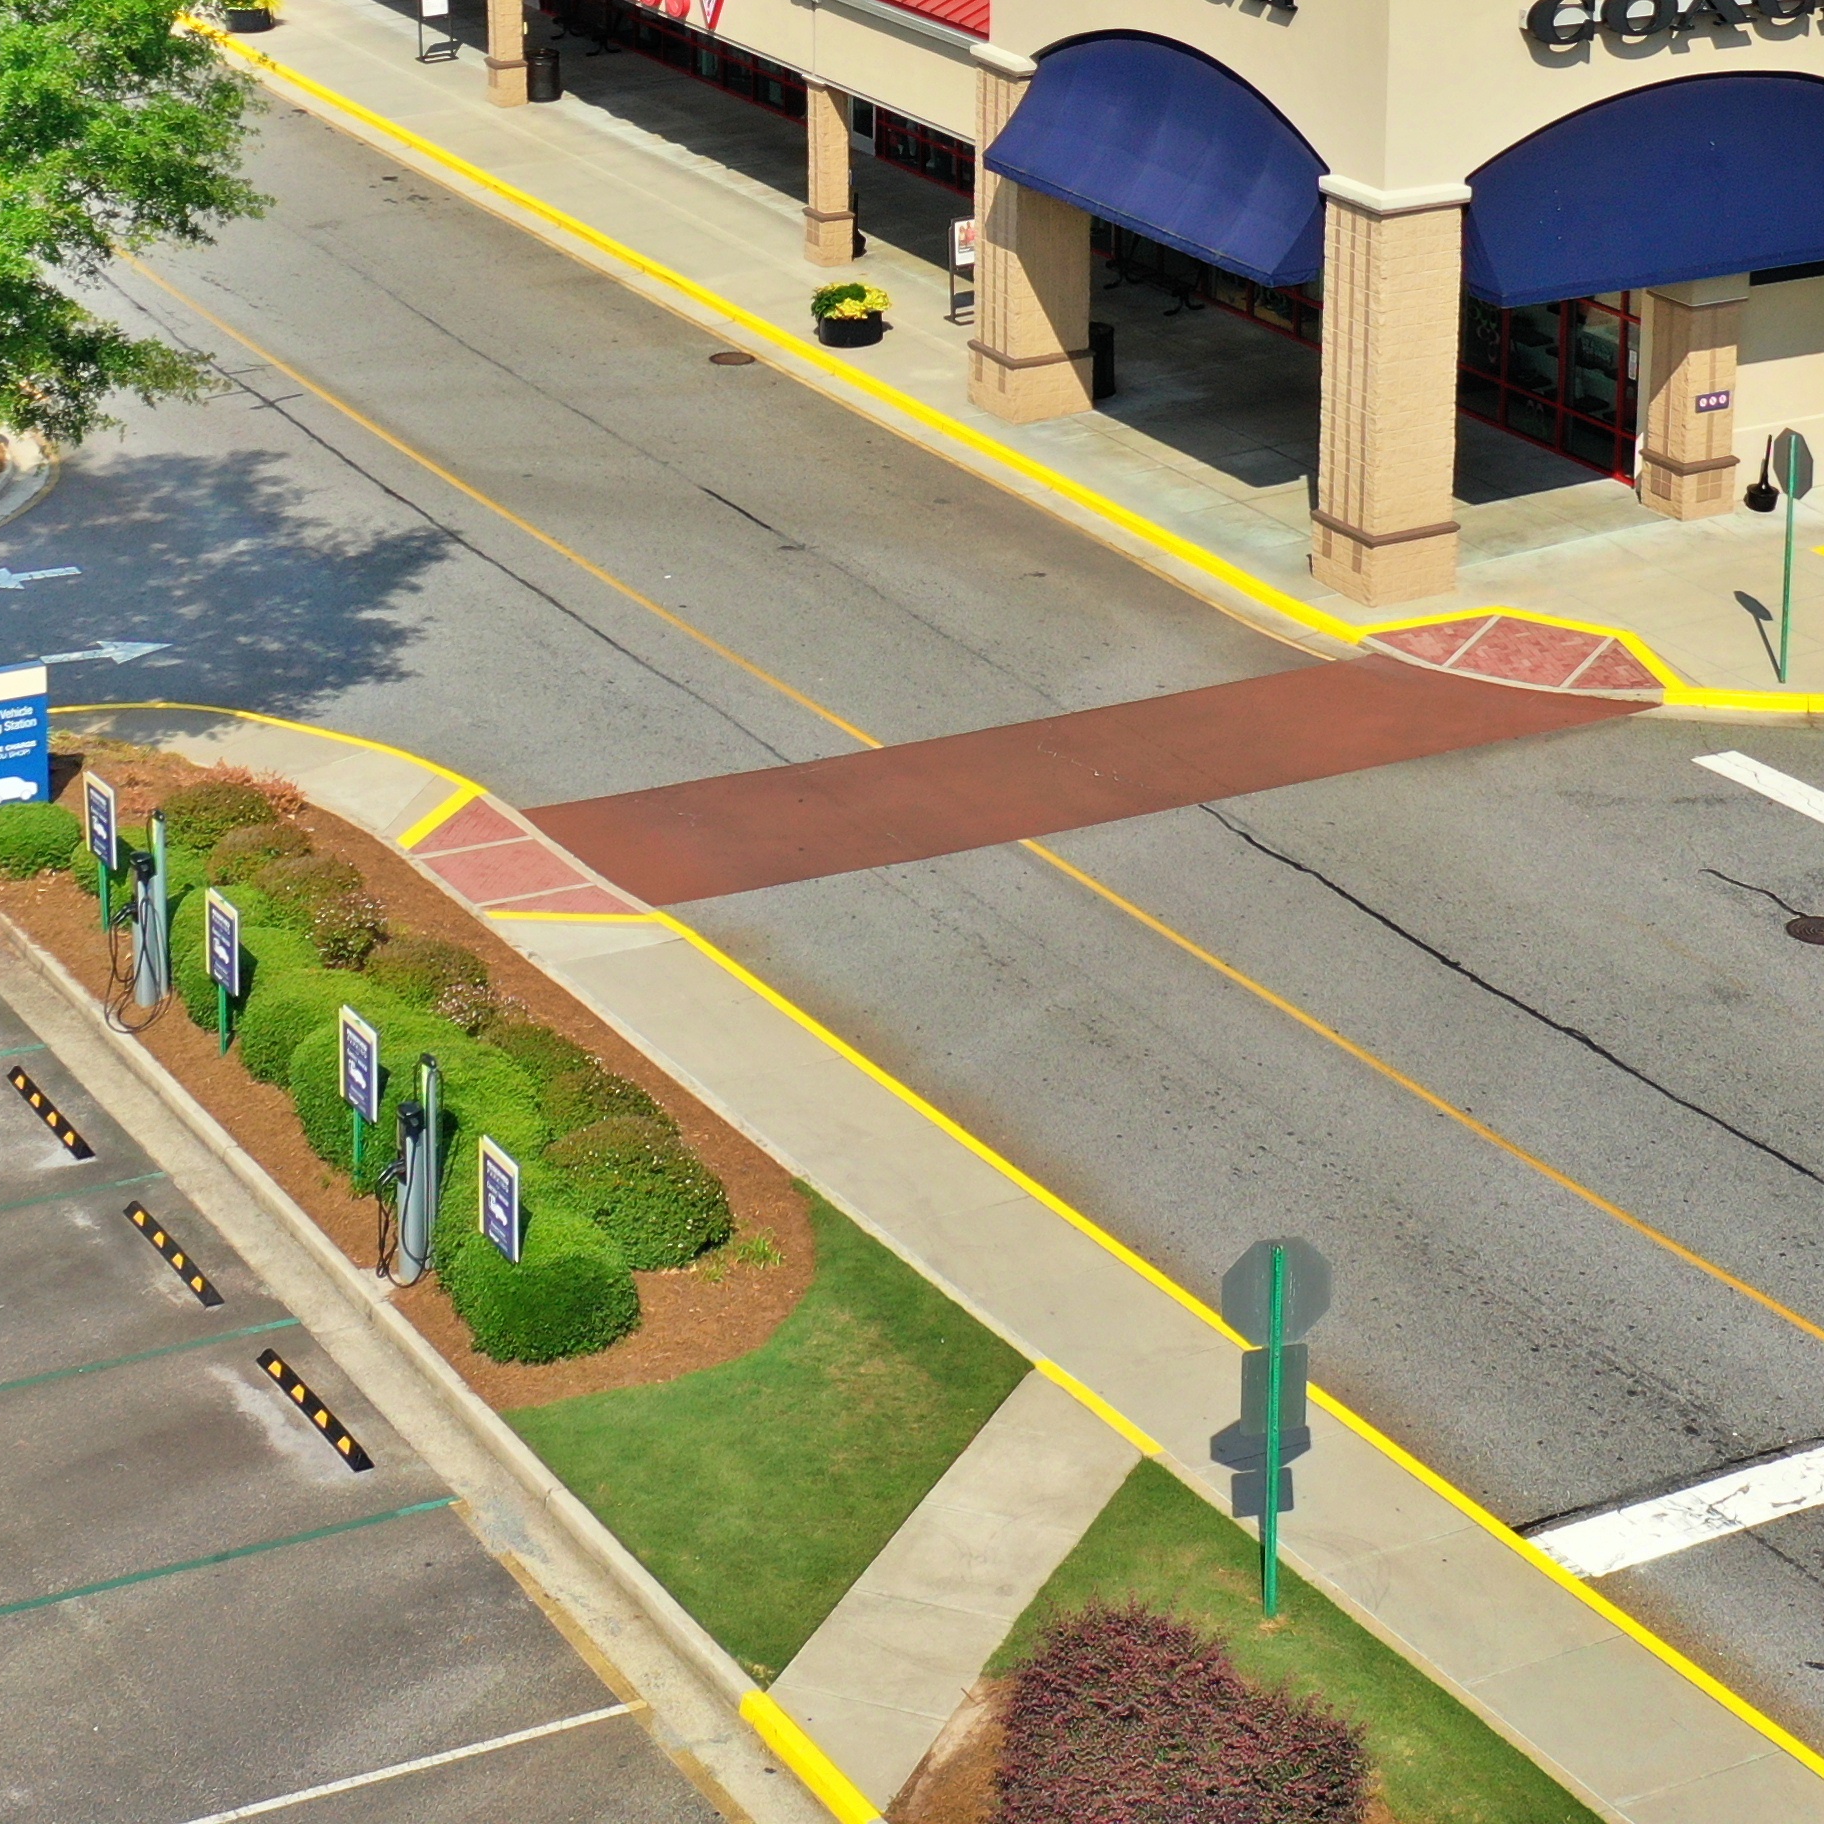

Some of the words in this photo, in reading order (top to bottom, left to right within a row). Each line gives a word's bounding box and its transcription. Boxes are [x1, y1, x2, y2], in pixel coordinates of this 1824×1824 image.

[0, 706, 34, 719] Vehicle
[4, 718, 37, 732] Station
[5, 740, 37, 751] CHARGE
